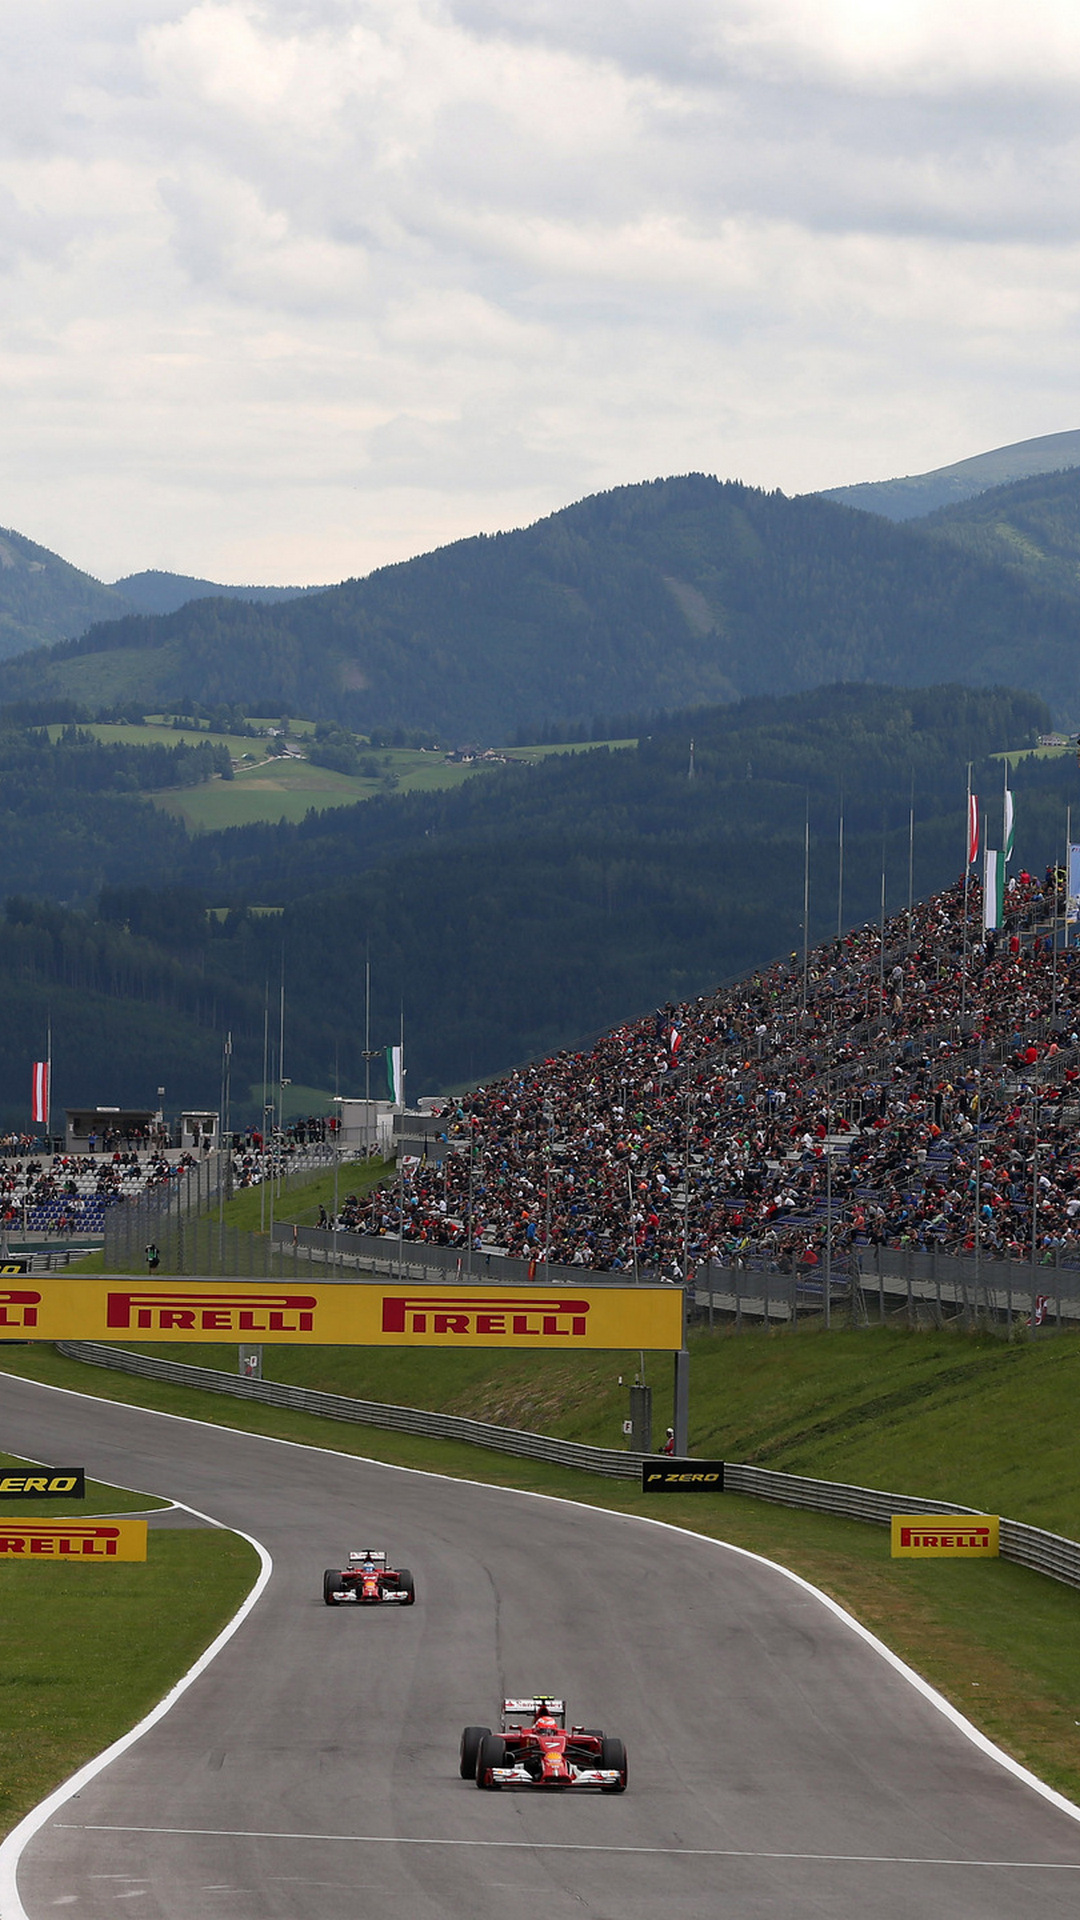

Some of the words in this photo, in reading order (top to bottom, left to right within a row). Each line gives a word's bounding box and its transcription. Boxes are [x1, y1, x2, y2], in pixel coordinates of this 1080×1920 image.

[107, 1293, 317, 1331] PIRELLI
[382, 1298, 590, 1335] PIRELLI
[0, 1477, 77, 1492] ERO
[647, 1474, 662, 1482] P
[665, 1473, 719, 1482] ZERO
[0, 1525, 120, 1555] RELLI
[901, 1527, 989, 1547] PIRELLI
